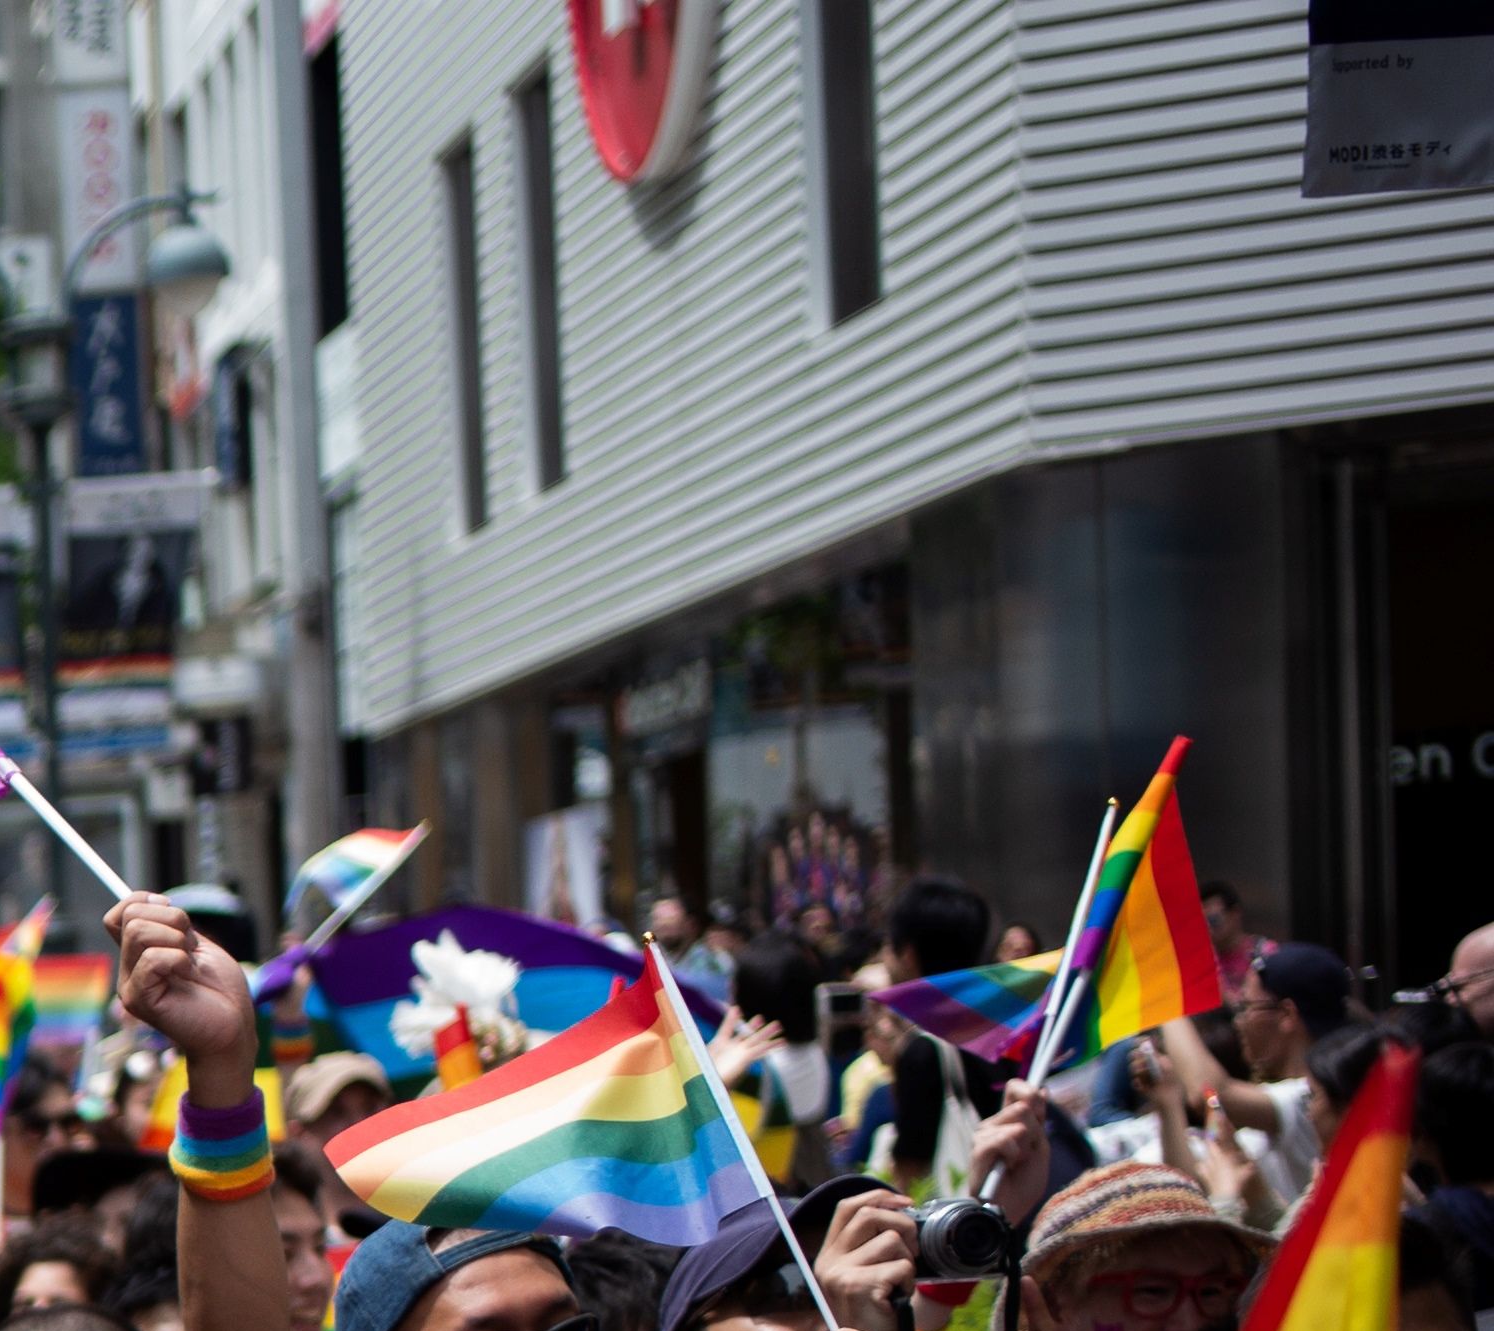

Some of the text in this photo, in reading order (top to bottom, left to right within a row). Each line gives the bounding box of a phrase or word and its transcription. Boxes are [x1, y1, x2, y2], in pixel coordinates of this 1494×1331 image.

[1396, 53, 1415, 70] by
[1328, 141, 1453, 163] MODI 渋谷モディ
